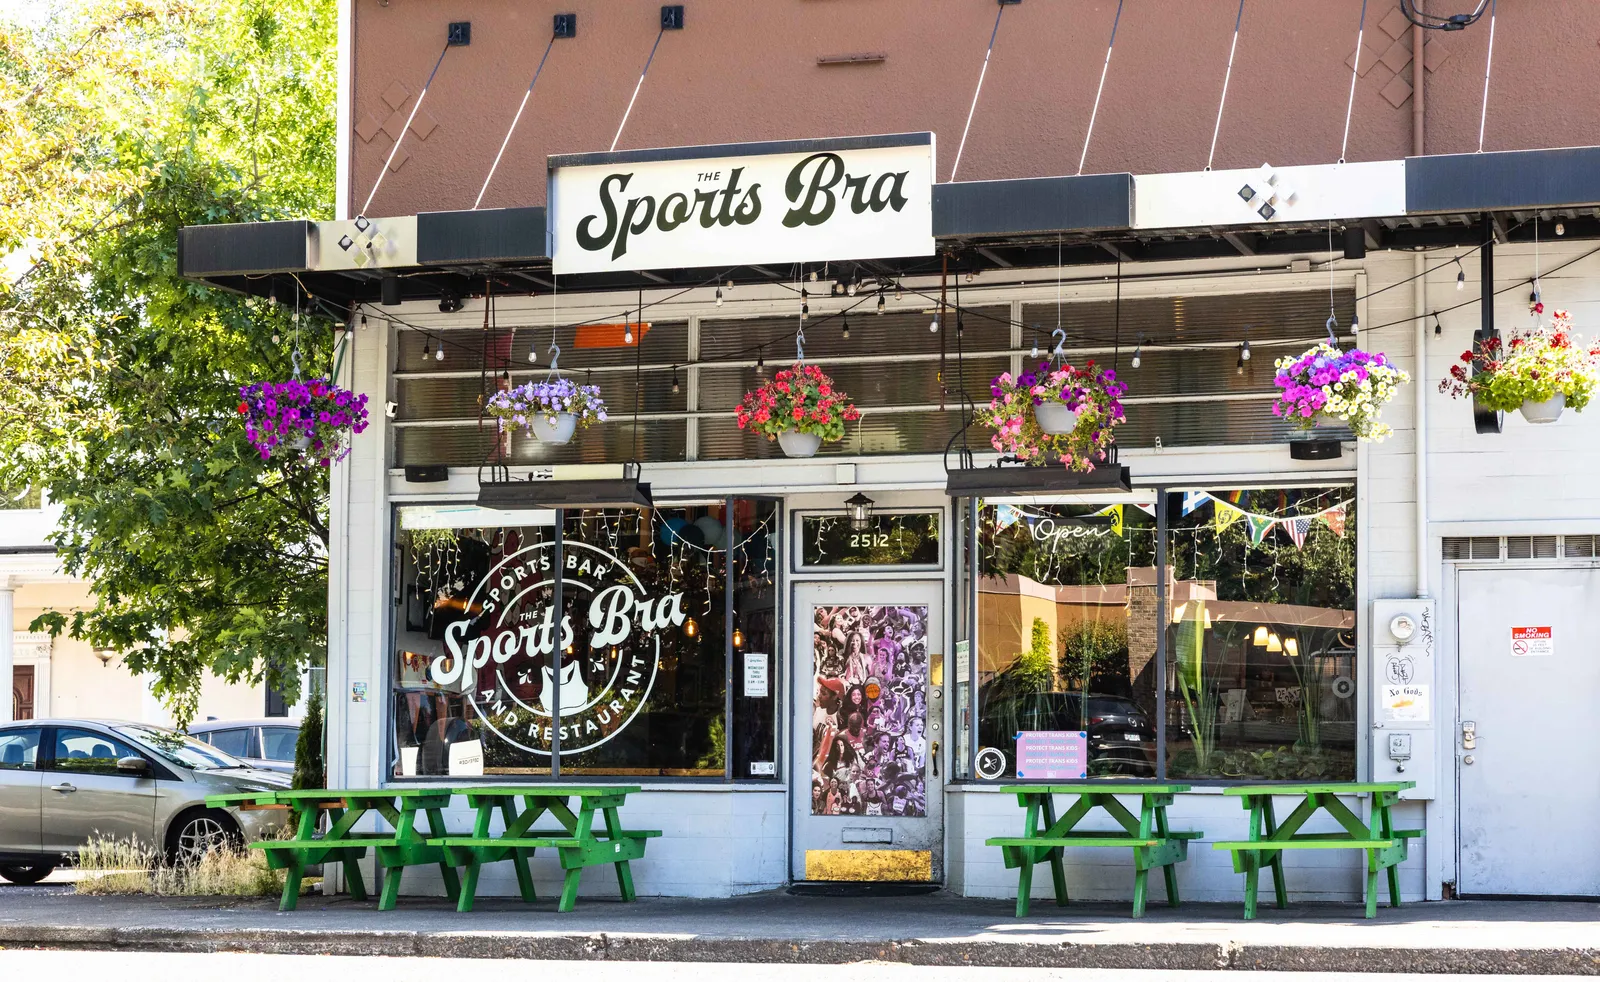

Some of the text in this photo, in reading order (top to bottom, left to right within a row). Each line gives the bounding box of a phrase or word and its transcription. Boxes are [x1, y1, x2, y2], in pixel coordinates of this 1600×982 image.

[697, 171, 721, 183] THE
[576, 152, 910, 262] Sports Bra
[850, 534, 889, 548] 2512
[1034, 518, 1110, 552] Open
[482, 554, 606, 613] SPORTS BAR
[431, 584, 687, 690] Sports Bra
[519, 610, 538, 621] THE
[481, 655, 645, 741] AND RESTAURANT
